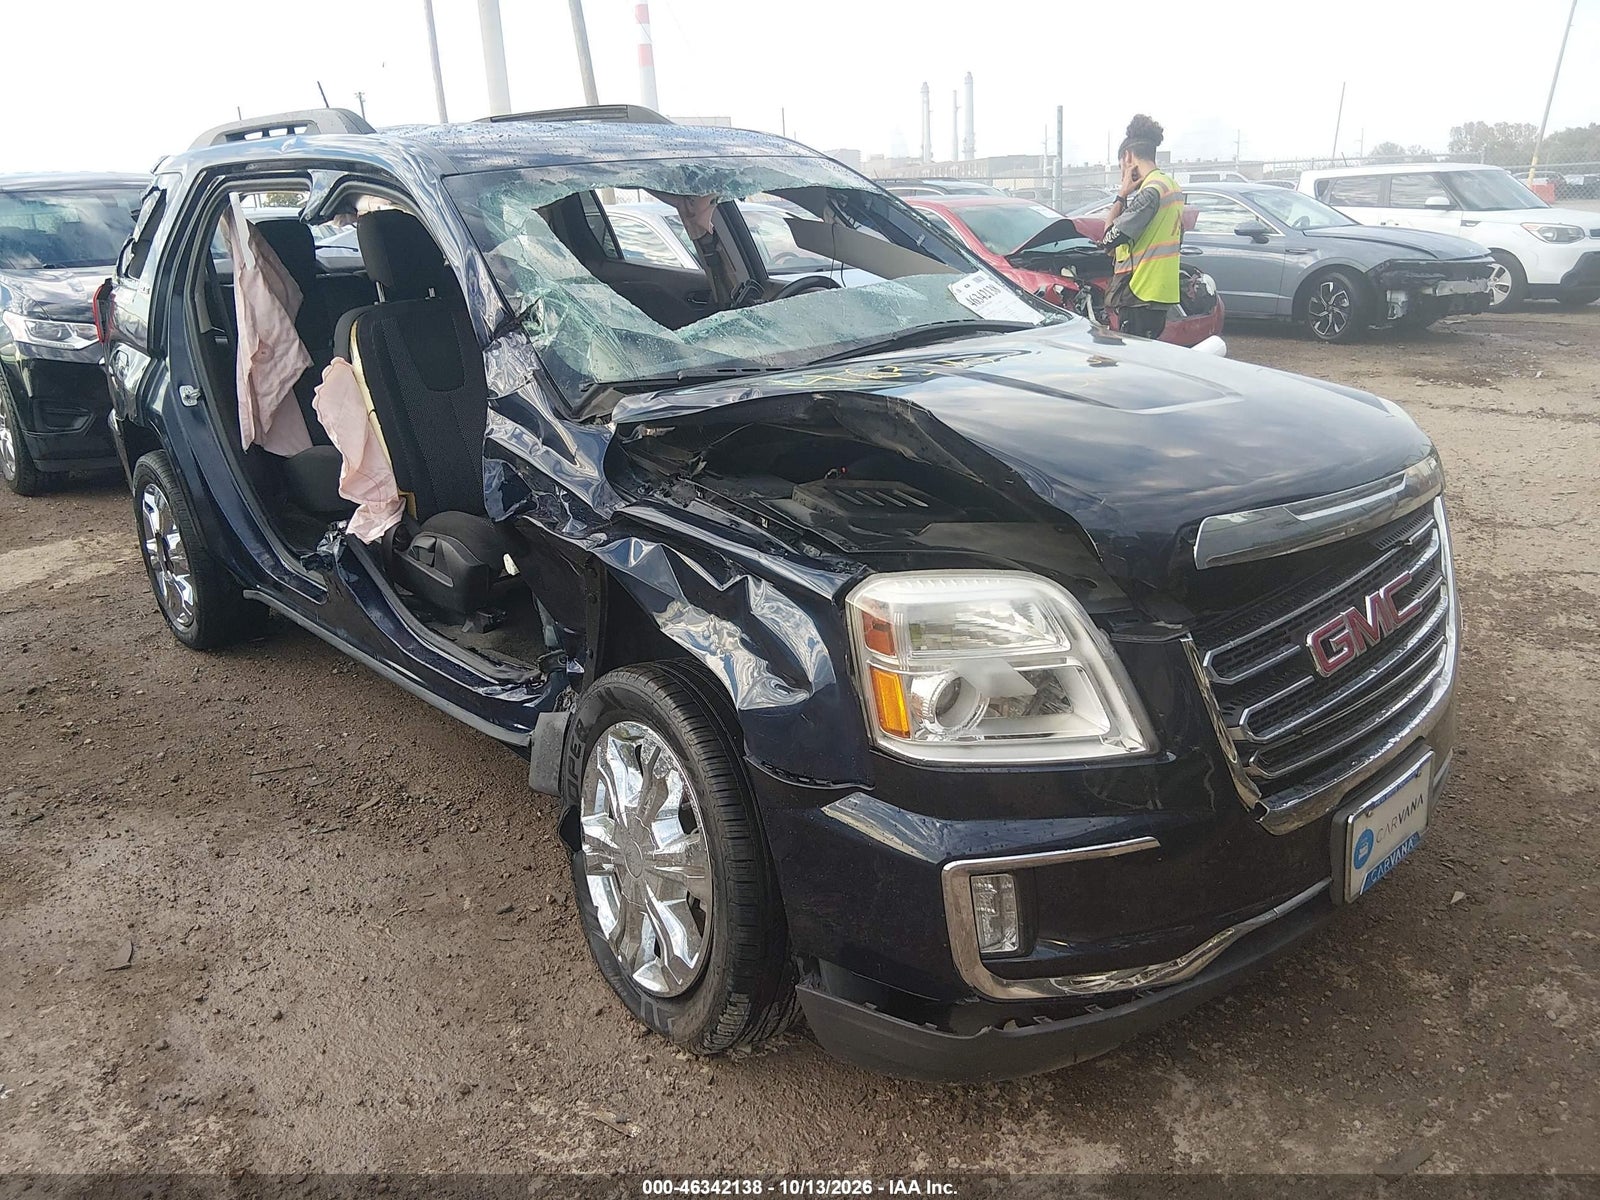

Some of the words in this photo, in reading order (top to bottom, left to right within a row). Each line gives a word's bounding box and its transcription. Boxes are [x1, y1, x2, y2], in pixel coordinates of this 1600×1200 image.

[1306, 570, 1423, 678] GMC
[1375, 792, 1424, 844] CARVANA
[1370, 836, 1415, 883] CARVANA
